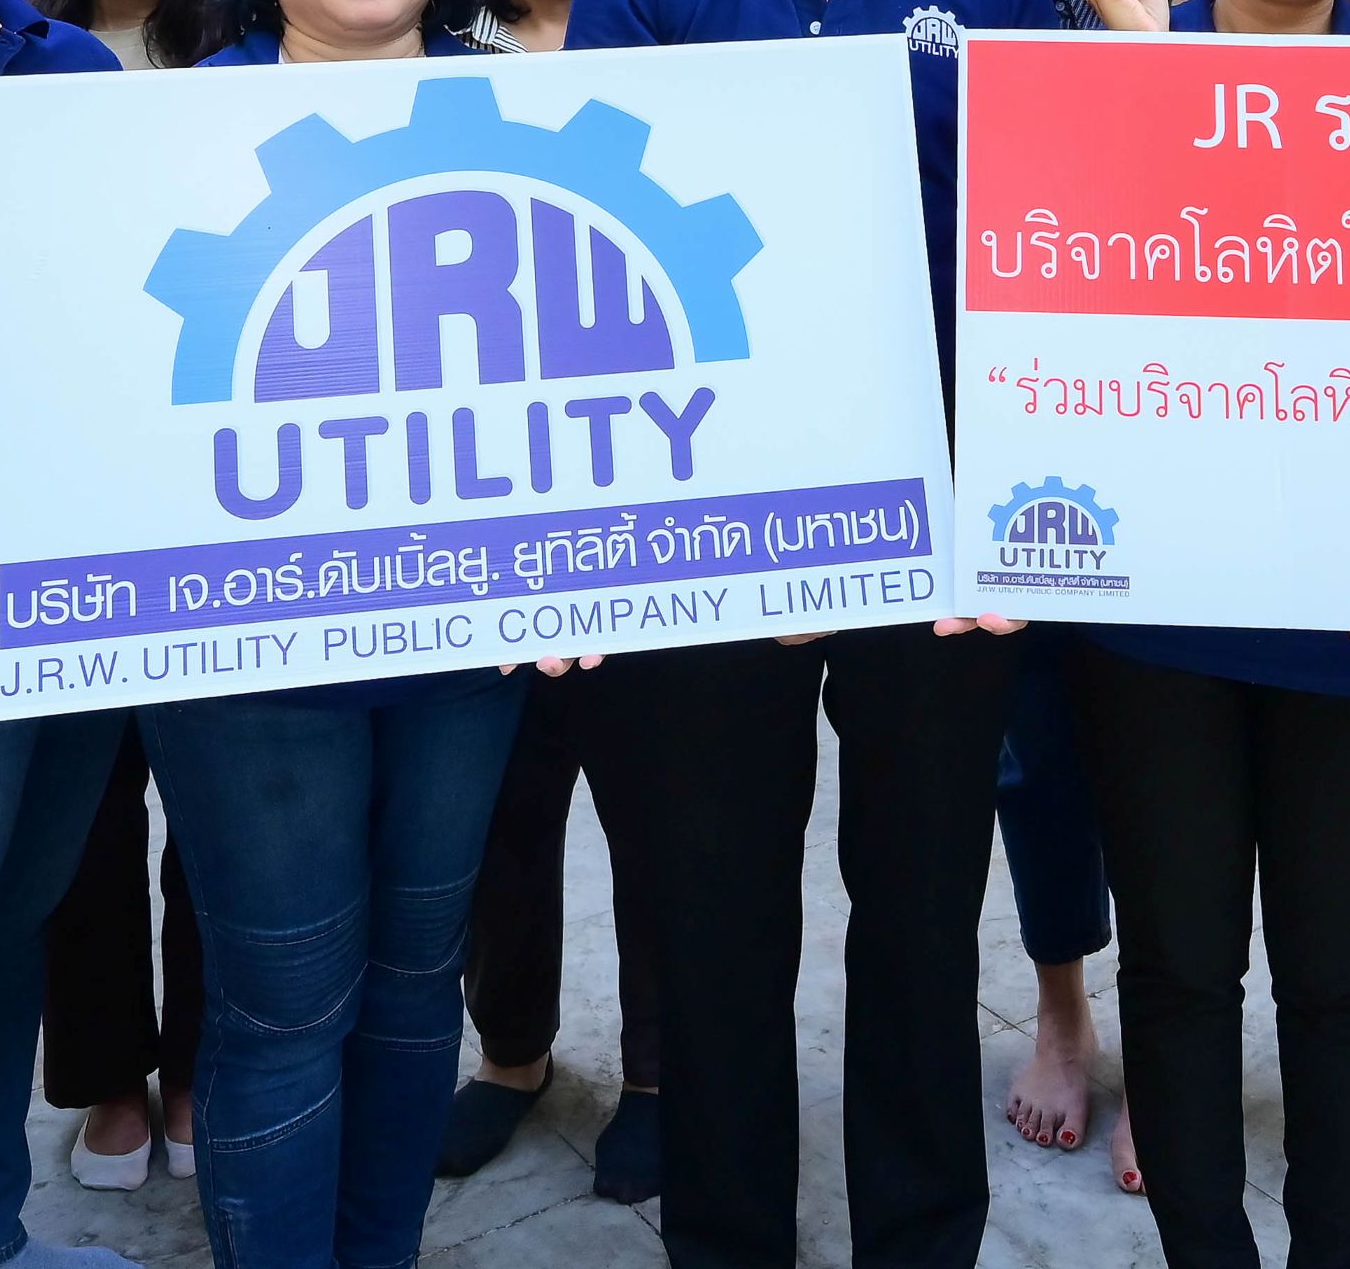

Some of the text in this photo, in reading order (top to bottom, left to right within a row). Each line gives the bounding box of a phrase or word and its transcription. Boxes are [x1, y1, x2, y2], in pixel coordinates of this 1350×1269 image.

[909, 38, 959, 59] UTILITY
[1193, 83, 1283, 150] JR
[253, 189, 676, 404] JRW
[213, 386, 716, 520] UTILITY
[5, 573, 137, 630] บริษัท
[513, 513, 639, 591] ยูทิลิตี้
[646, 513, 752, 565] จำกัด
[763, 499, 920, 564] (มหาชน)
[1000, 547, 1107, 570] UTILITY
[1054, 588, 1095, 597] COMPANY
[1098, 590, 1130, 598] LIMITED
[0, 568, 935, 697] J.R.W. UTILITY PUBLIC COMPANY LIMITED
